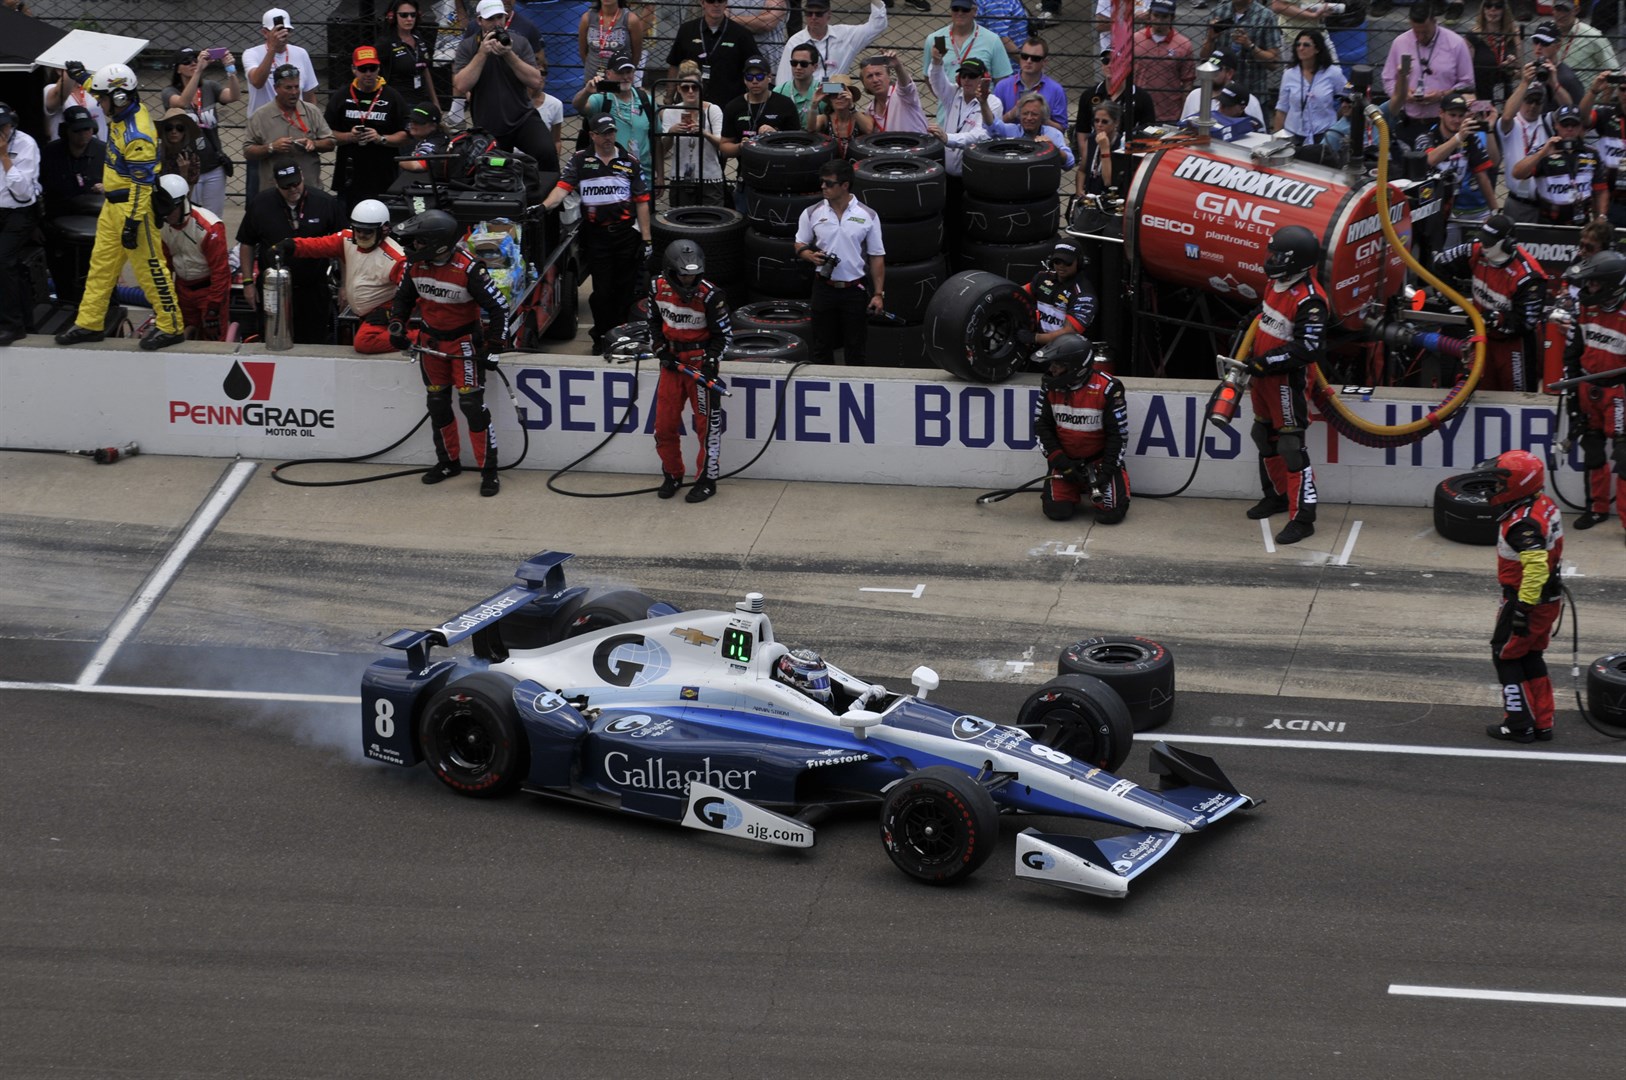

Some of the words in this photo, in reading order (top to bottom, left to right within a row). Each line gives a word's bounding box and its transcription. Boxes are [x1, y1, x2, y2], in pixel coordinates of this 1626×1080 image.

[1174, 156, 1328, 208] HYDROXYCUT
[1195, 191, 1281, 228] GNC
[1141, 214, 1195, 236] GEICO
[1193, 211, 1226, 226] LIVE
[1234, 218, 1273, 237] WELL
[1205, 230, 1260, 250] plantronics
[1237, 261, 1265, 274] mole
[148, 258, 177, 313] SUNOCO
[265, 428, 298, 437] MOTOR
[300, 429, 315, 438] OIL
[442, 597, 518, 633] Gallagher
[593, 633, 645, 687] G
[375, 698, 395, 738] 8
[1263, 708, 1346, 733] INDY
[368, 750, 404, 765] Firestone
[806, 753, 869, 769] Firestone
[1031, 744, 1072, 765] 8
[604, 751, 756, 796] Gallagher
[747, 823, 804, 843] ajg.com
